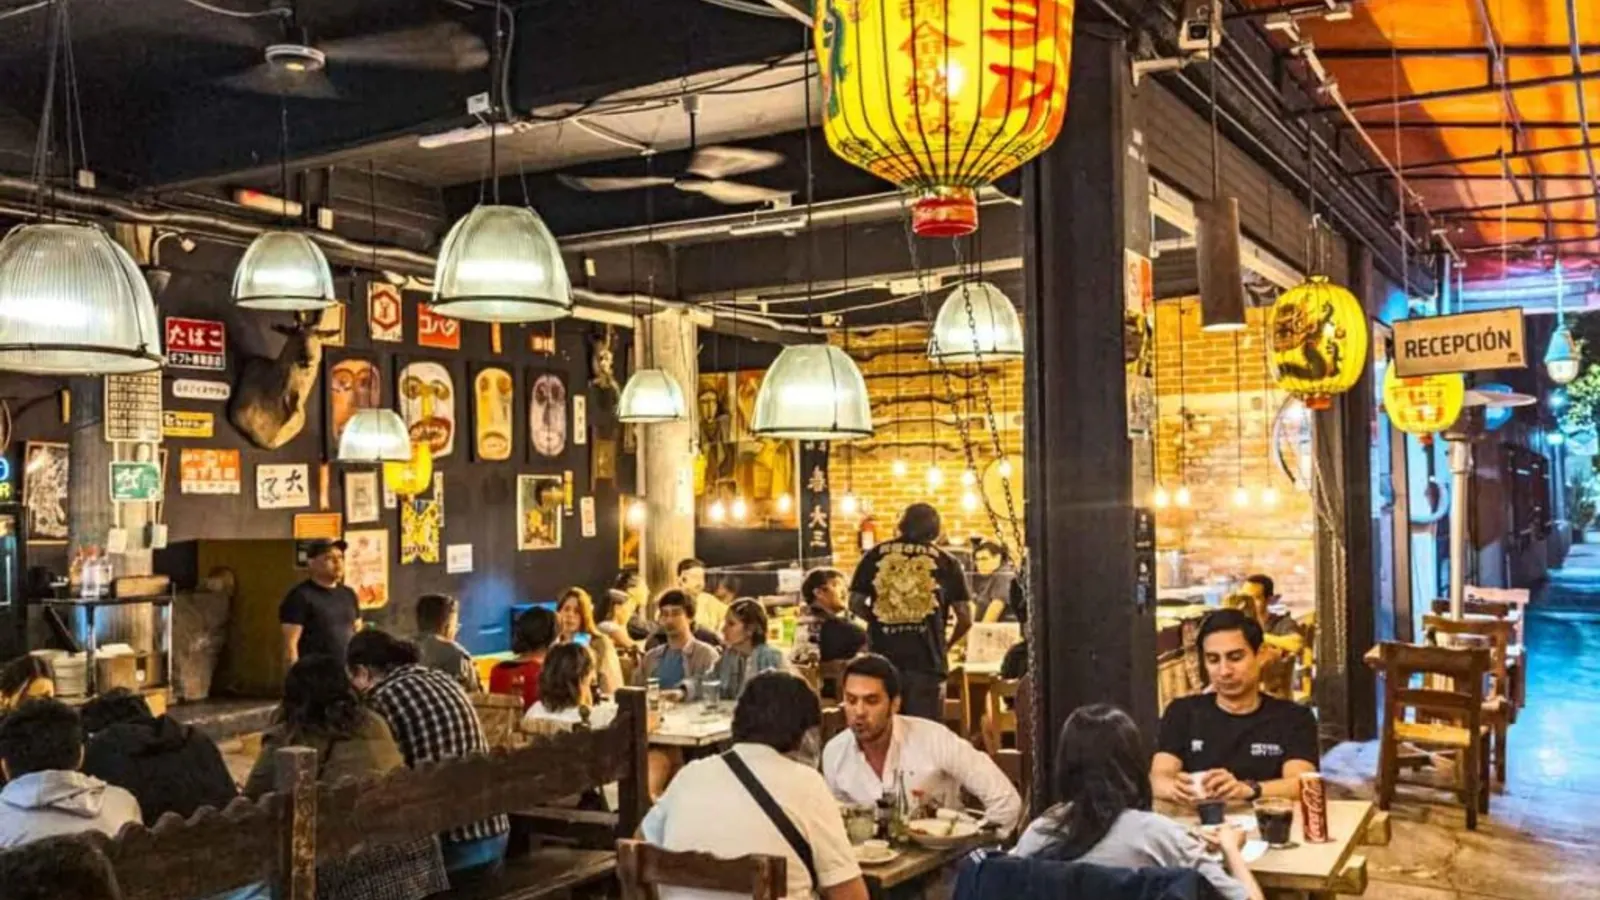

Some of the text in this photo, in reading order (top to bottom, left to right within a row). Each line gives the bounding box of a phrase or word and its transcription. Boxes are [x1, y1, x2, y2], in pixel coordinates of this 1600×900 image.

[168, 324, 222, 347] たばこ
[1404, 326, 1512, 359] RECEPCIÓN
